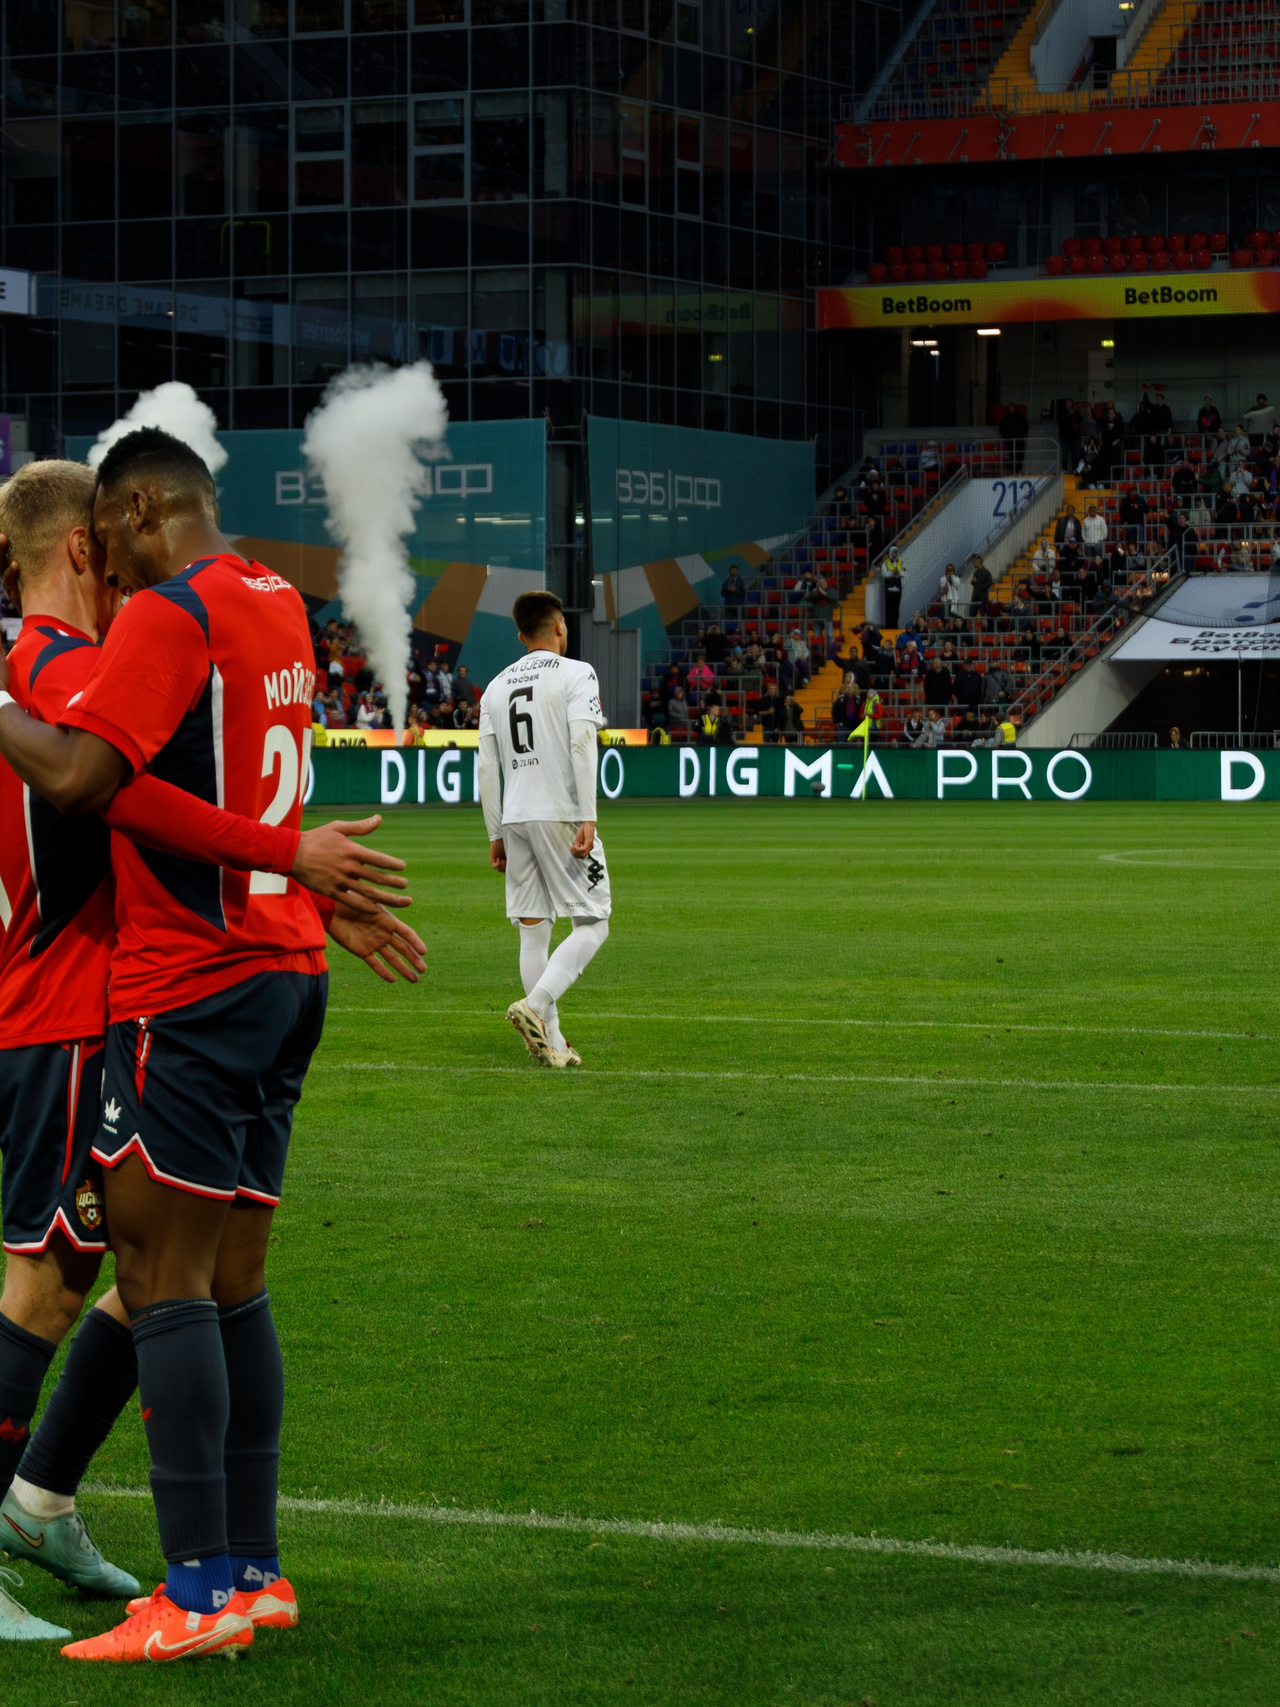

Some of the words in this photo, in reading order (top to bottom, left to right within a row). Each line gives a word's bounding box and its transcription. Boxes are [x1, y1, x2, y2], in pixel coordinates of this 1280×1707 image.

[881, 296, 972, 315] BetBoom
[1124, 286, 1218, 305] BetBoom
[508, 685, 535, 755] 6
[381, 749, 480, 804] DIG
[679, 747, 894, 799] DIGMA
[936, 748, 1093, 800] PRO
[1220, 749, 1266, 802] D
